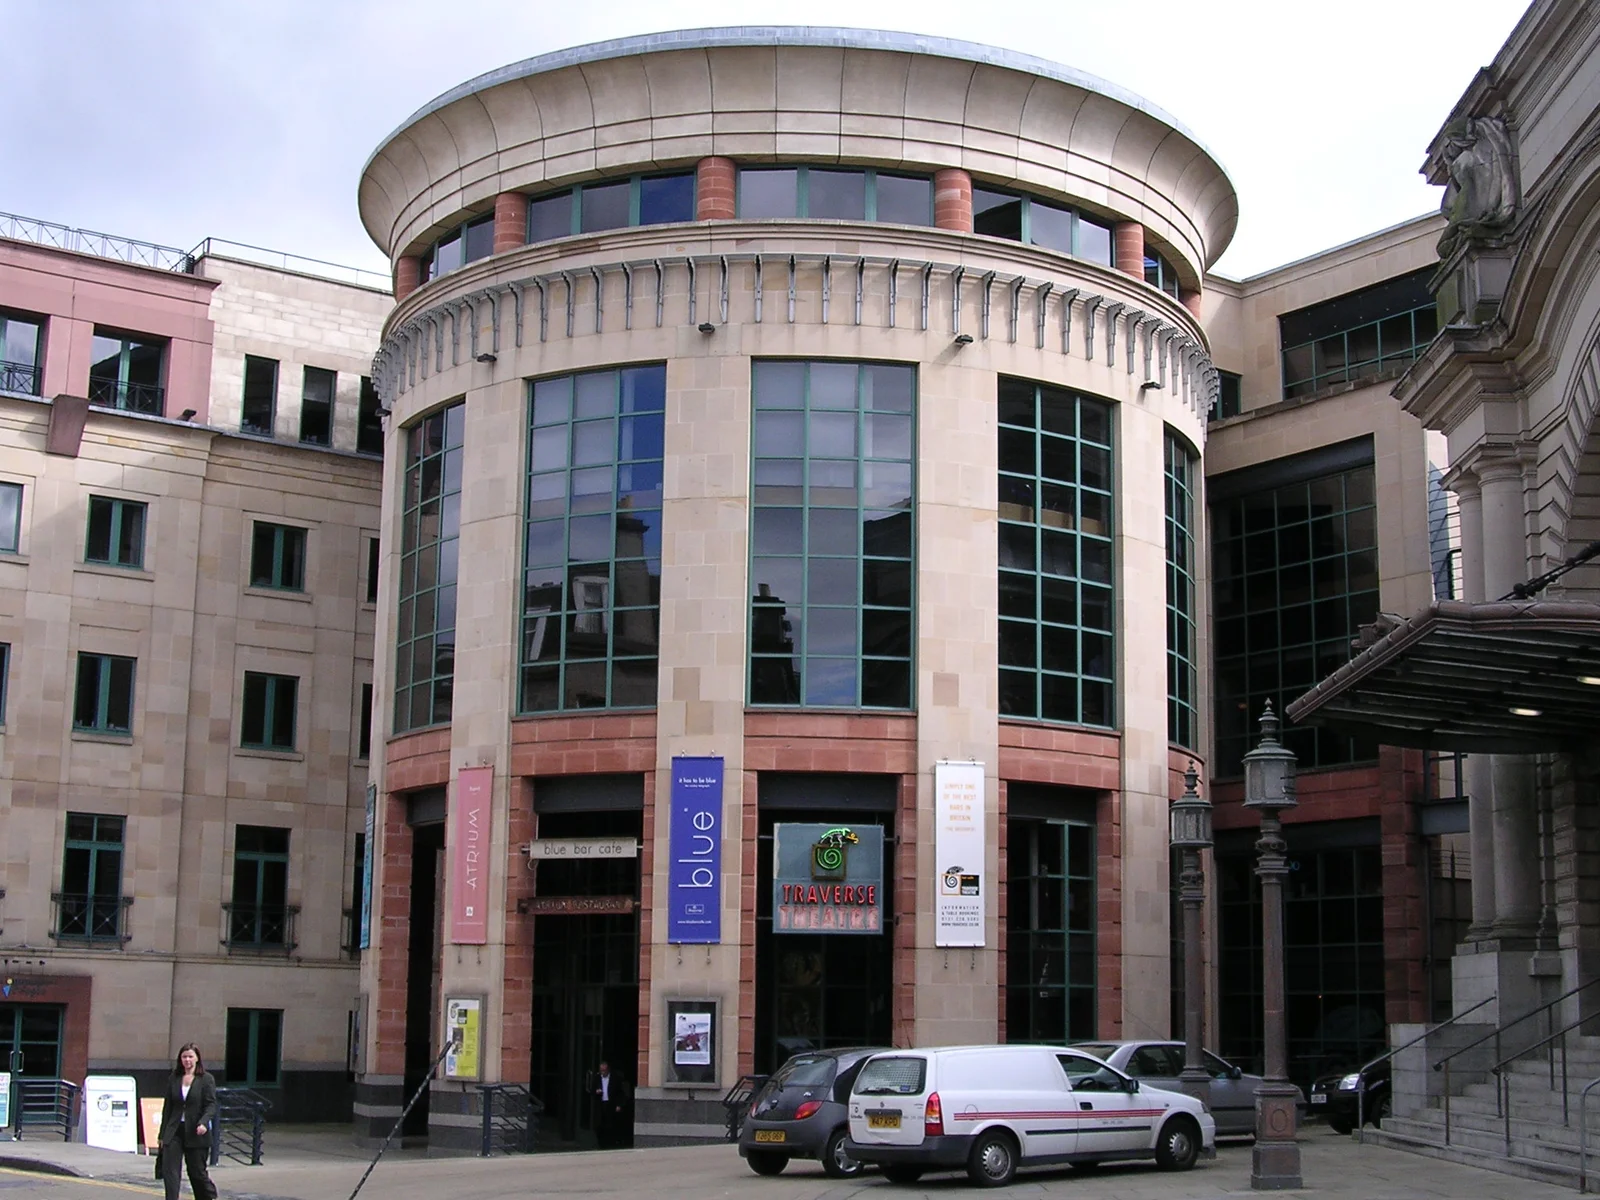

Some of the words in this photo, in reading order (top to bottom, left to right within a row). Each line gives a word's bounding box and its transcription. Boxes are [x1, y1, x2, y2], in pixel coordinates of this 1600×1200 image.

[466, 807, 481, 891] ATRIUM
[544, 842, 566, 855] blue
[573, 842, 593, 855] bar
[598, 841, 622, 854] cafe
[678, 810, 715, 888] blue
[782, 884, 876, 905] TRAVERSE
[778, 905, 880, 931] THEATRE
